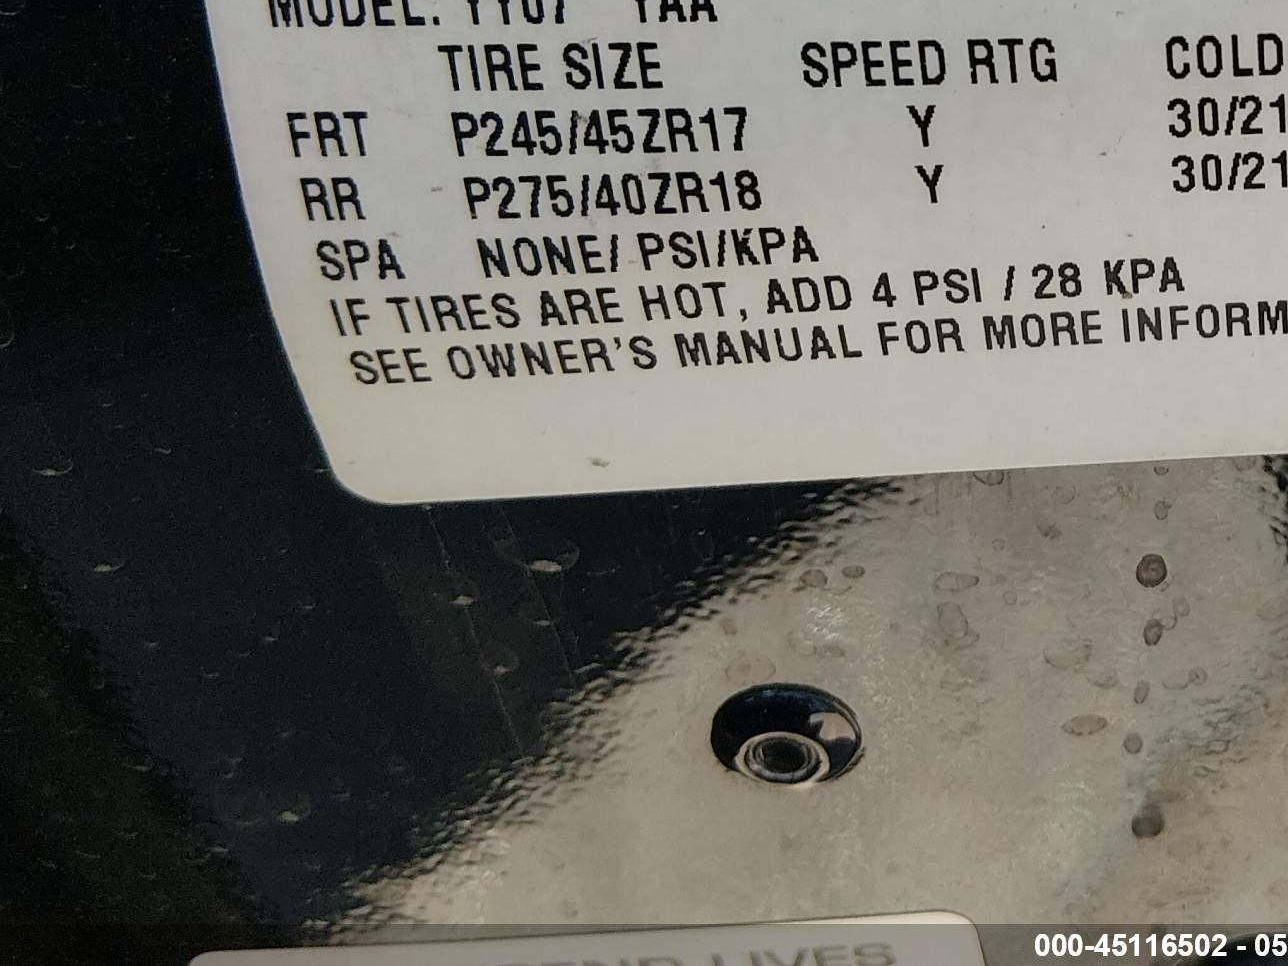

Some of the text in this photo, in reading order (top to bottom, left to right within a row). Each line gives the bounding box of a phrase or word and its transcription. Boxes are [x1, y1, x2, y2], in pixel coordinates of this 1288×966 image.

[437, 41, 664, 92] TIRE SIZE
[800, 37, 1058, 88] SPEED RTG
[1165, 32, 1284, 80] COLD
[285, 104, 937, 158] FRT P245/45ZR17 Y
[299, 164, 945, 222] RR P275/40ZR18 Y
[315, 225, 820, 282] SPA NONE/ PSI/KPA
[329, 256, 1186, 338] IF TIRES ARE HOT, ADD 4 PSI / 28 KPA
[349, 347, 433, 385] SEE
[446, 335, 658, 380] OWNER'S
[673, 324, 863, 368] MANUAL
[876, 317, 966, 357] FOR
[982, 309, 1103, 351] MORE
